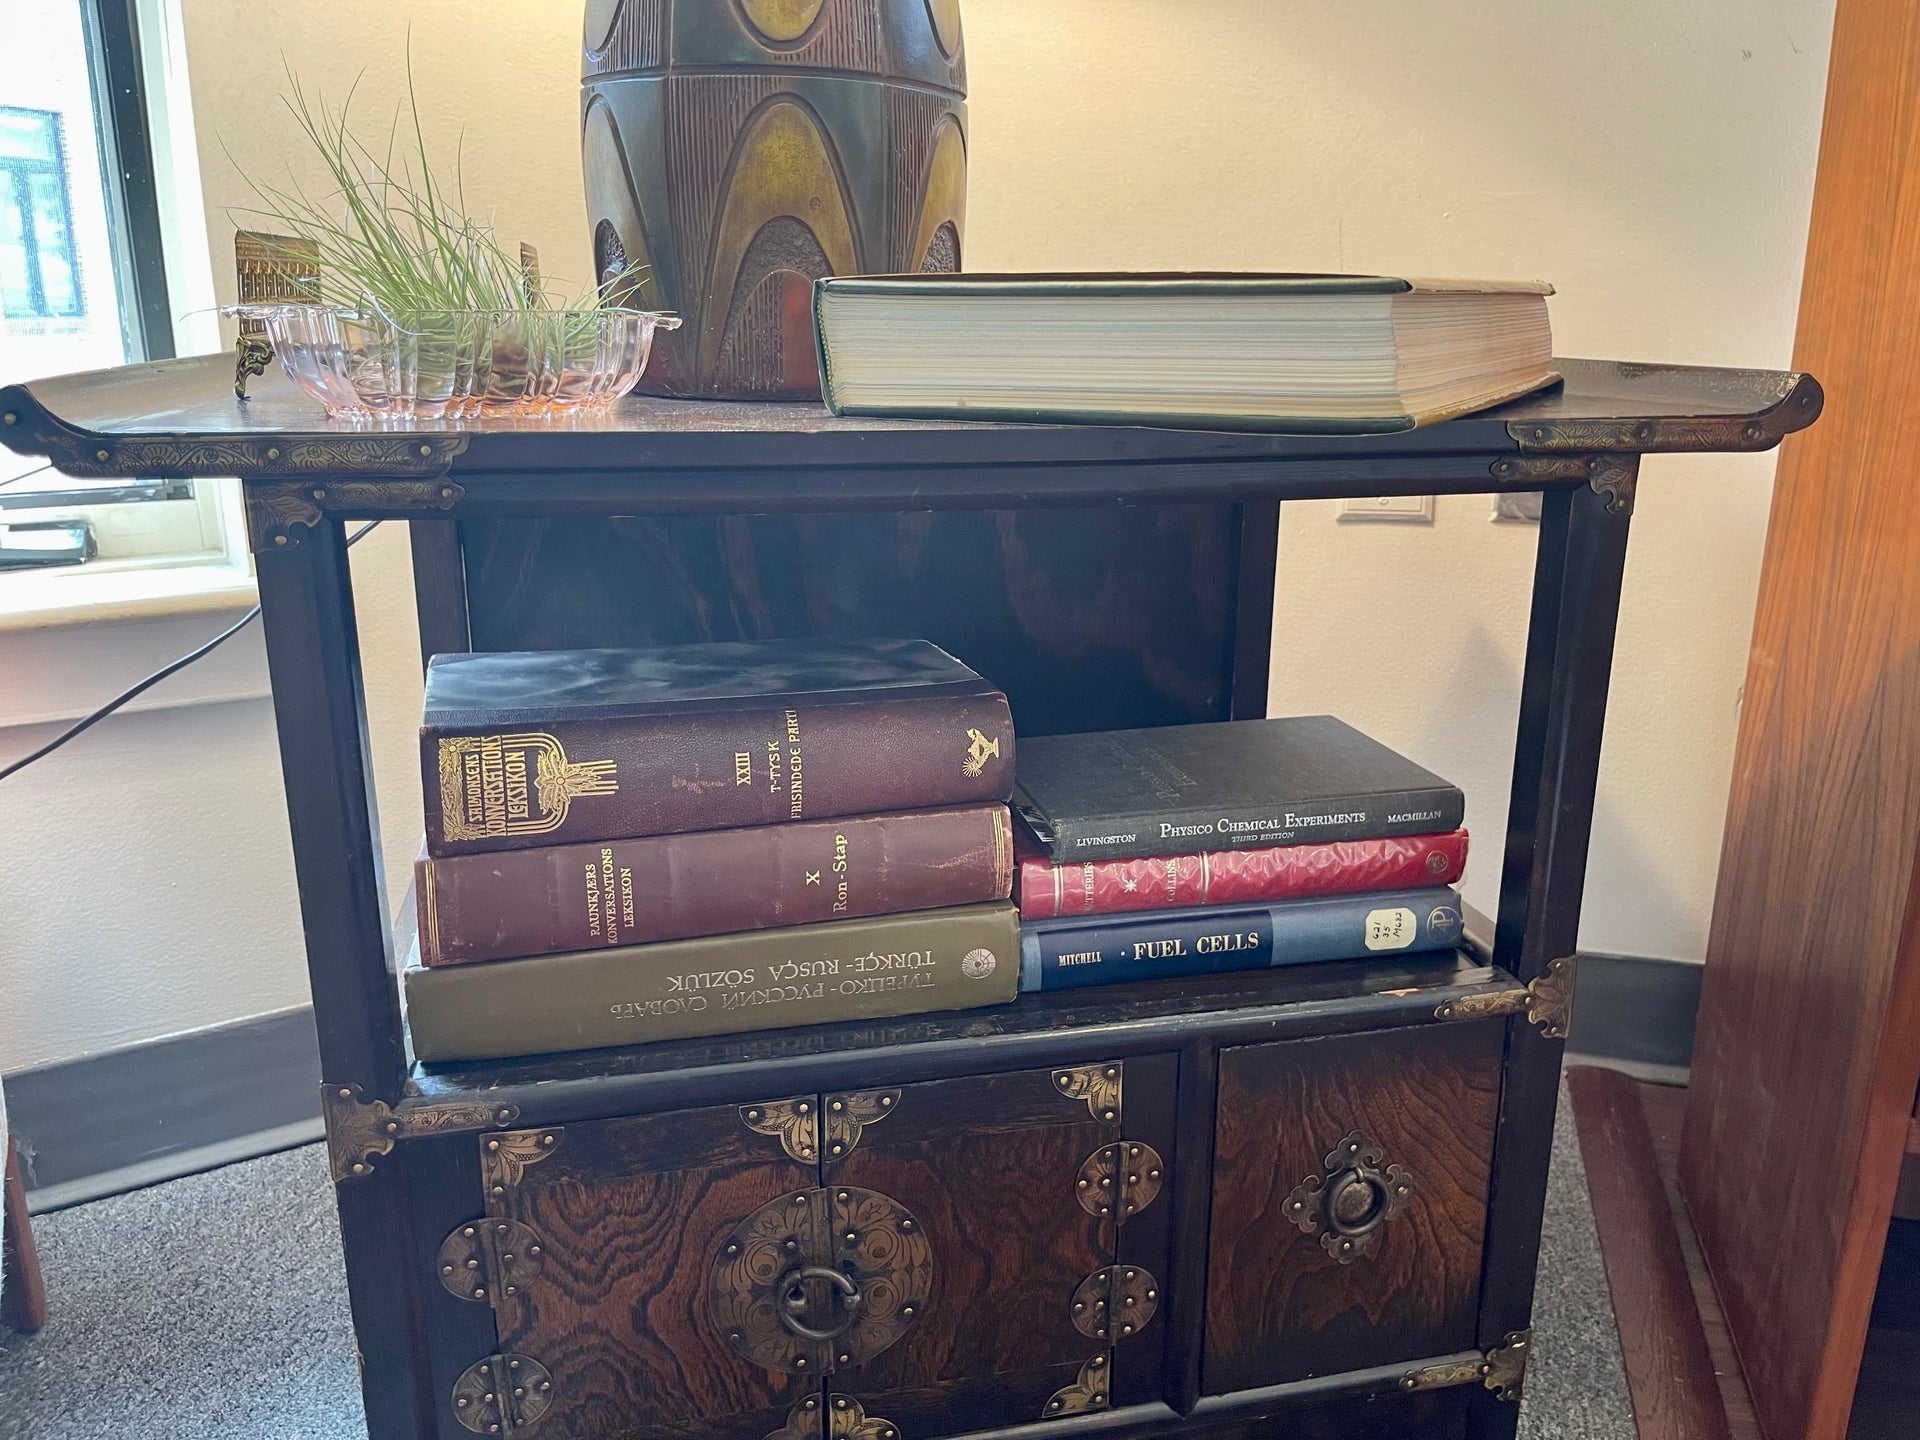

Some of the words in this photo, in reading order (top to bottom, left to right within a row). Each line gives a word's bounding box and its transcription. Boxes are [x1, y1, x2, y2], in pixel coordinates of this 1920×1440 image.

[735, 751, 751, 786] XXIII
[767, 740, 782, 793] T-TYSK
[790, 747, 803, 819] FRISINDEDE
[464, 753, 482, 822] SALMONSENS
[481, 735, 507, 837] KONVERSATIONS
[504, 751, 529, 819] LEKSIKON
[1387, 810, 1442, 823] MACMILLAN
[1076, 833, 1136, 847] LIVINGSTON
[1230, 834, 1258, 843] THIRD
[1259, 831, 1295, 841] EDITION
[806, 869, 820, 886] X
[1166, 859, 1177, 902] COLLINS
[585, 863, 600, 936] RAUNKJÆRS
[601, 848, 618, 944] KONVERSATIONS
[620, 867, 634, 928] LEKSIKON
[1132, 939, 1187, 960] FUEL
[1196, 932, 1260, 954] CELLS
[1372, 921, 1381, 940] 621
[1058, 951, 1102, 966] MITCHELL
[666, 968, 755, 992] SÖZLÜK
[609, 995, 707, 1019] СЛОВАРЬ
